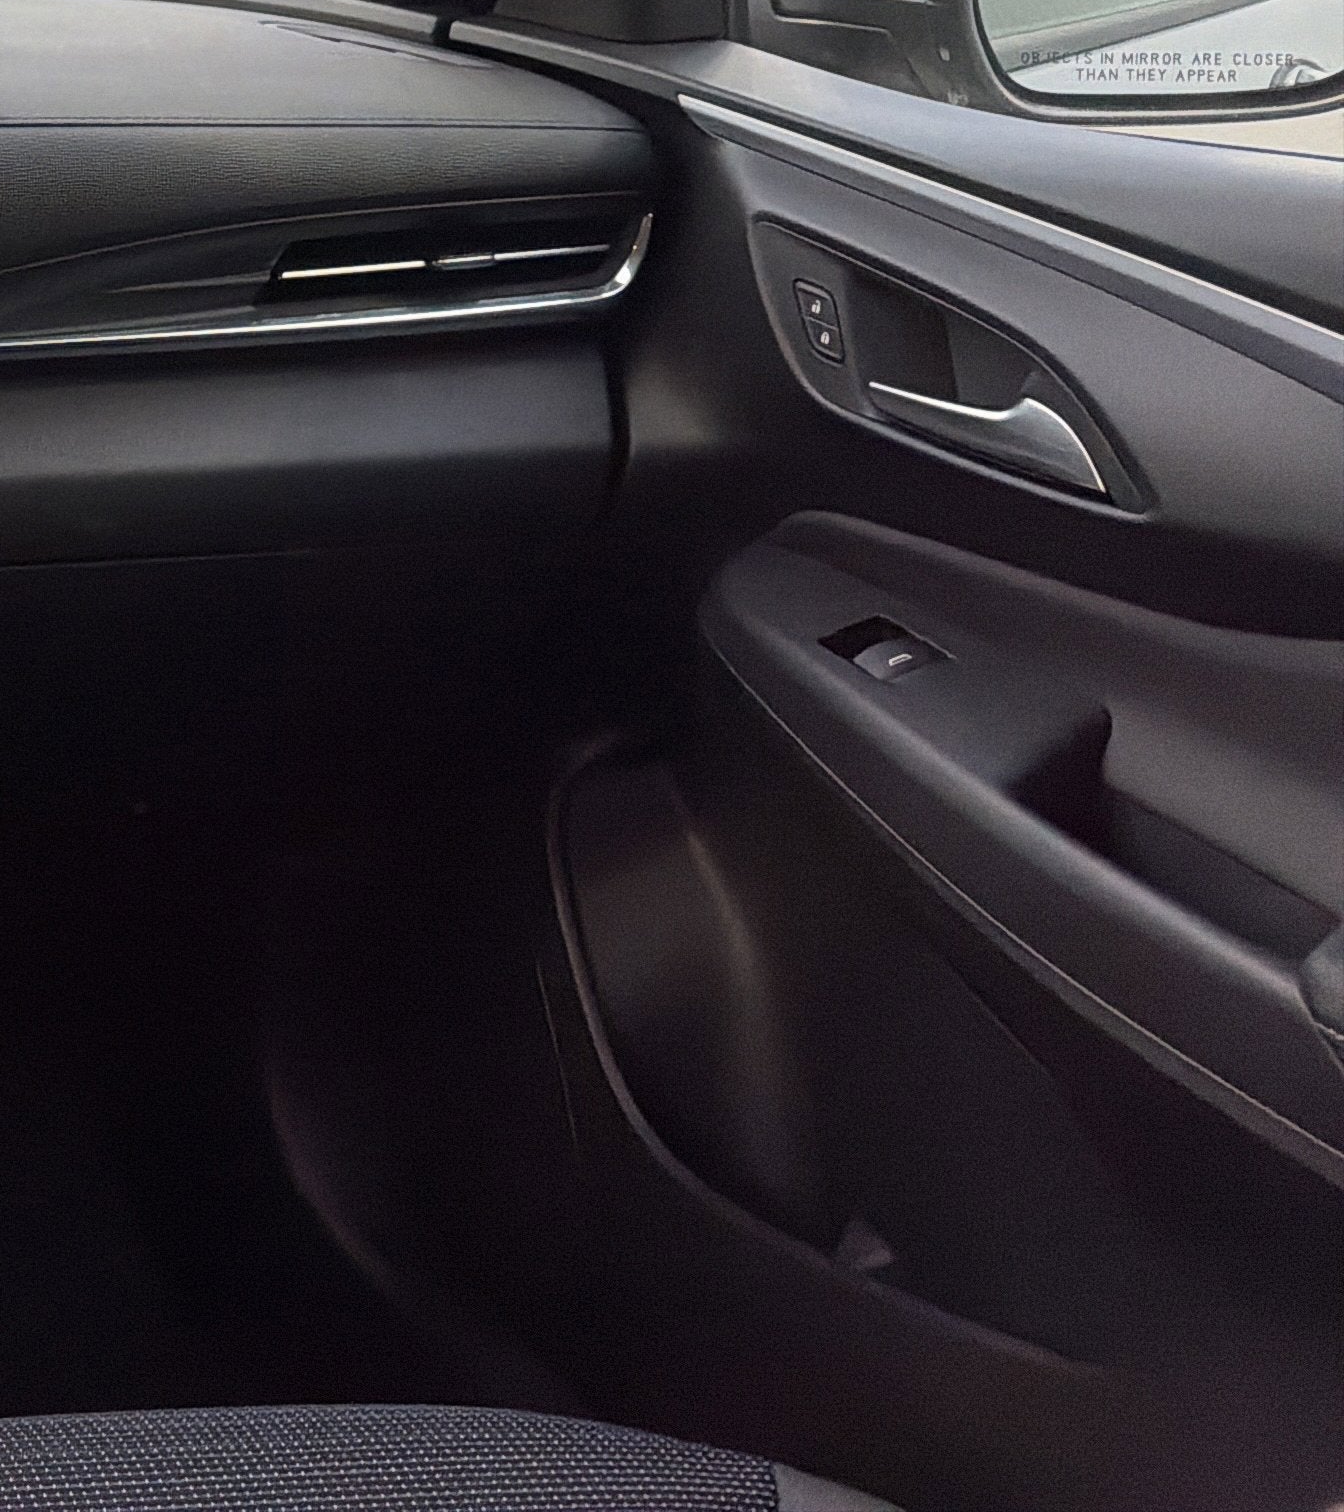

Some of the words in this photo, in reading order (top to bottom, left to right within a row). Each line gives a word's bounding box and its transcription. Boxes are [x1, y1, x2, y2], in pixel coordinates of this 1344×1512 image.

[1020, 51, 1093, 65] OBJECTS
[1100, 52, 1114, 65] IN
[1122, 52, 1181, 65] MIRROR
[1192, 53, 1222, 65] ARE
[1232, 53, 1294, 66] CLOSER
[1075, 68, 1118, 81] THAN
[1127, 68, 1165, 82] THEY
[1175, 69, 1237, 82] APPEAR
